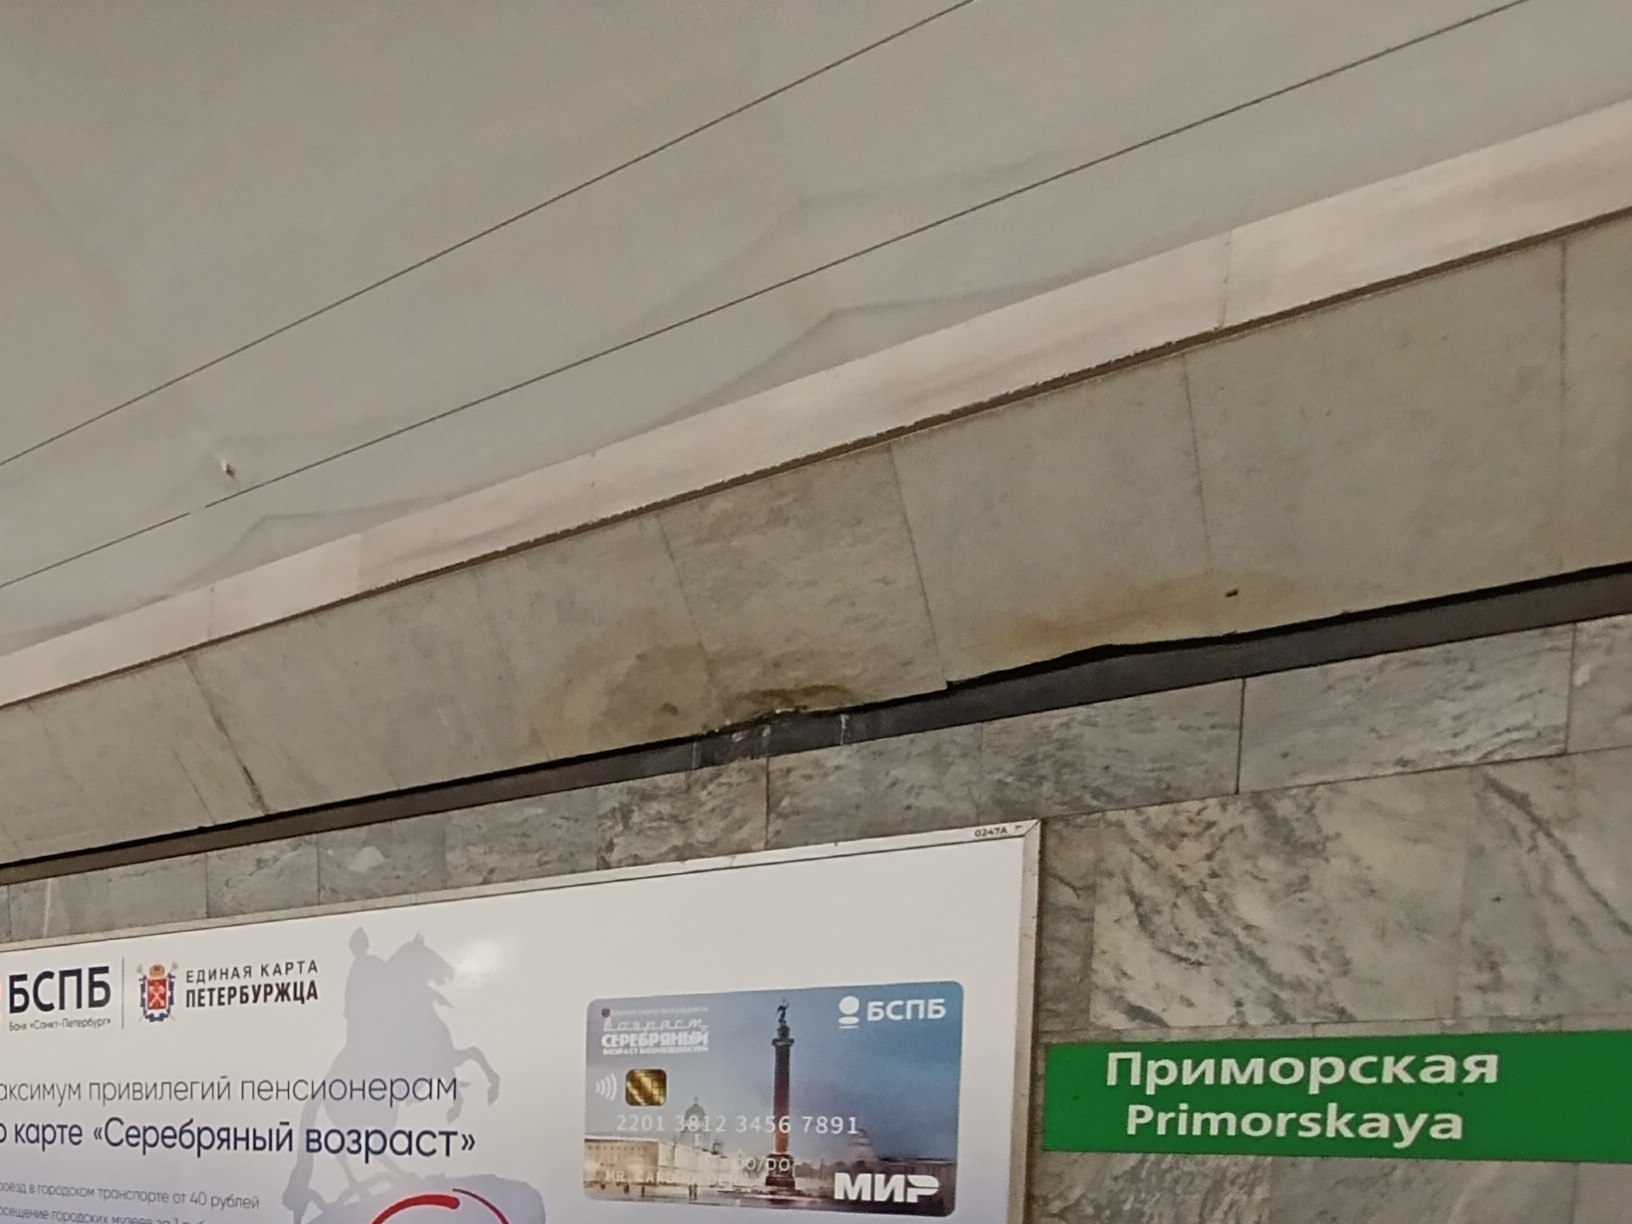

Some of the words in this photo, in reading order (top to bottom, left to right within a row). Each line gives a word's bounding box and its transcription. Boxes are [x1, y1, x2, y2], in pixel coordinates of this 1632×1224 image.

[186, 967, 252, 983] ЕДИНАЯ
[260, 960, 318, 977] КАРТА
[9, 966, 111, 1014] БСПБ
[186, 981, 318, 1008] ПЕТЕРБУРЖЦА
[867, 998, 946, 1021] БСПБ
[9, 1021, 27, 1032] Банк
[30, 1018, 111, 1031] «Санкт-Петербург»
[1106, 1050, 1499, 1096] Приморская
[89, 1075, 232, 1107] привилегий
[240, 1076, 458, 1109] пенсионерам
[616, 1115, 664, 1132] 2201
[675, 1115, 726, 1133] 3812
[736, 1115, 791, 1133] 3456
[801, 1115, 859, 1134] 7891
[1127, 1102, 1463, 1149] Primorskaya
[14, 1122, 82, 1151] карте
[93, 1117, 293, 1158] «Серебряный
[305, 1128, 476, 1164] возраст»
[29, 1184, 36, 1194] в
[37, 1185, 95, 1199] городском
[97, 1188, 169, 1206] транспорте
[172, 1193, 186, 1204] от
[189, 1191, 207, 1205] 40
[210, 1193, 260, 1210] рублей
[834, 1172, 940, 1203] МИР
